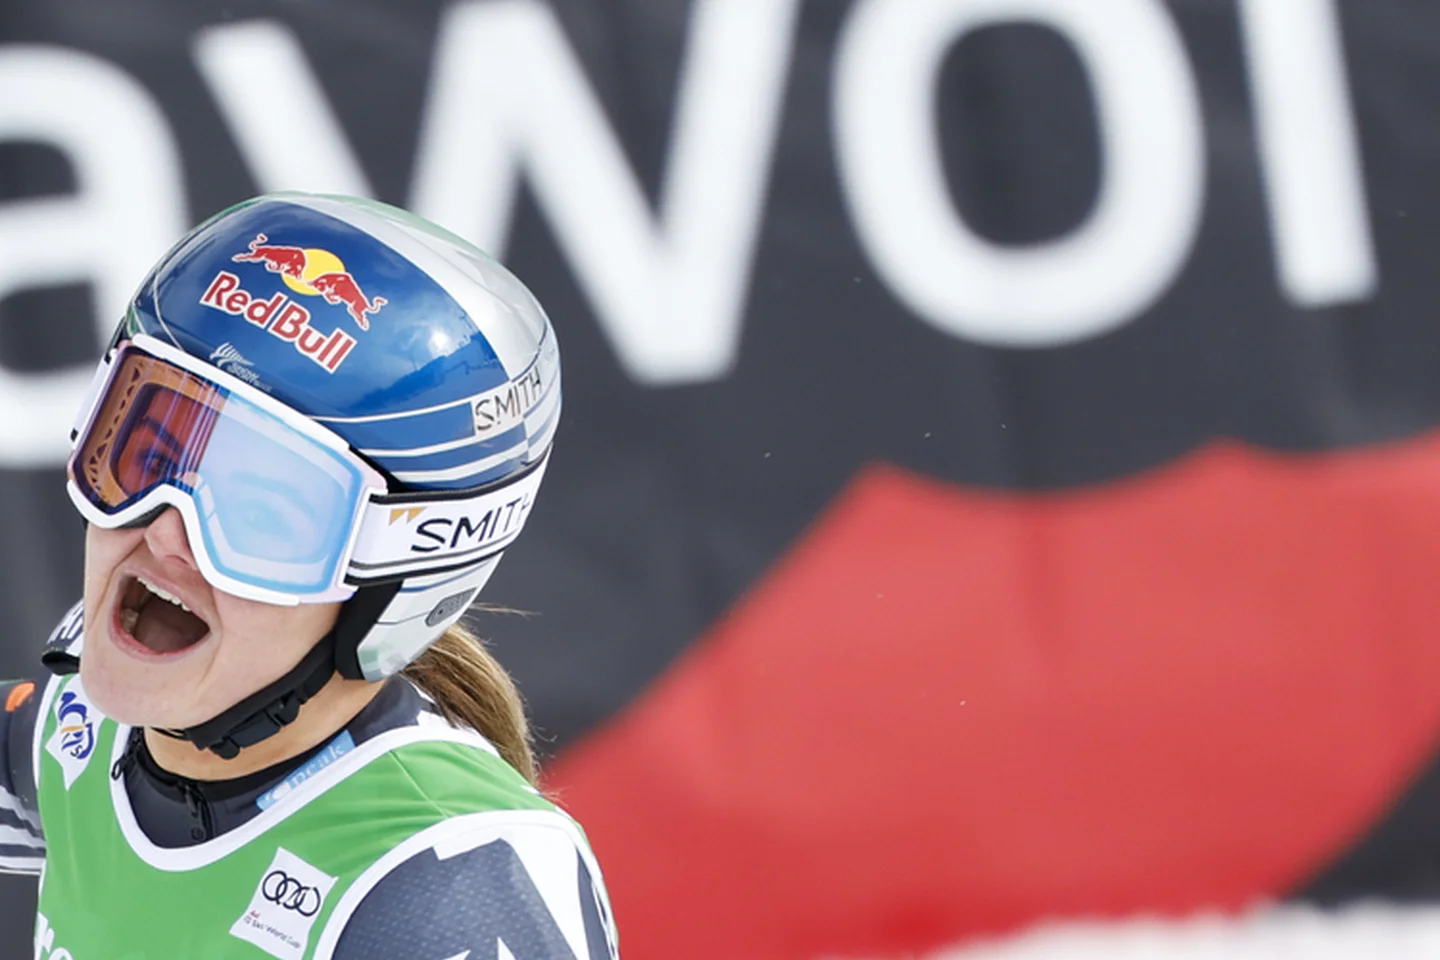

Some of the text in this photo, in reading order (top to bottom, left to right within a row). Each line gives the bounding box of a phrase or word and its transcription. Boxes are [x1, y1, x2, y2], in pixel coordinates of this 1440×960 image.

[201, 271, 356, 374] Red Bull
[474, 366, 543, 432] SMITH
